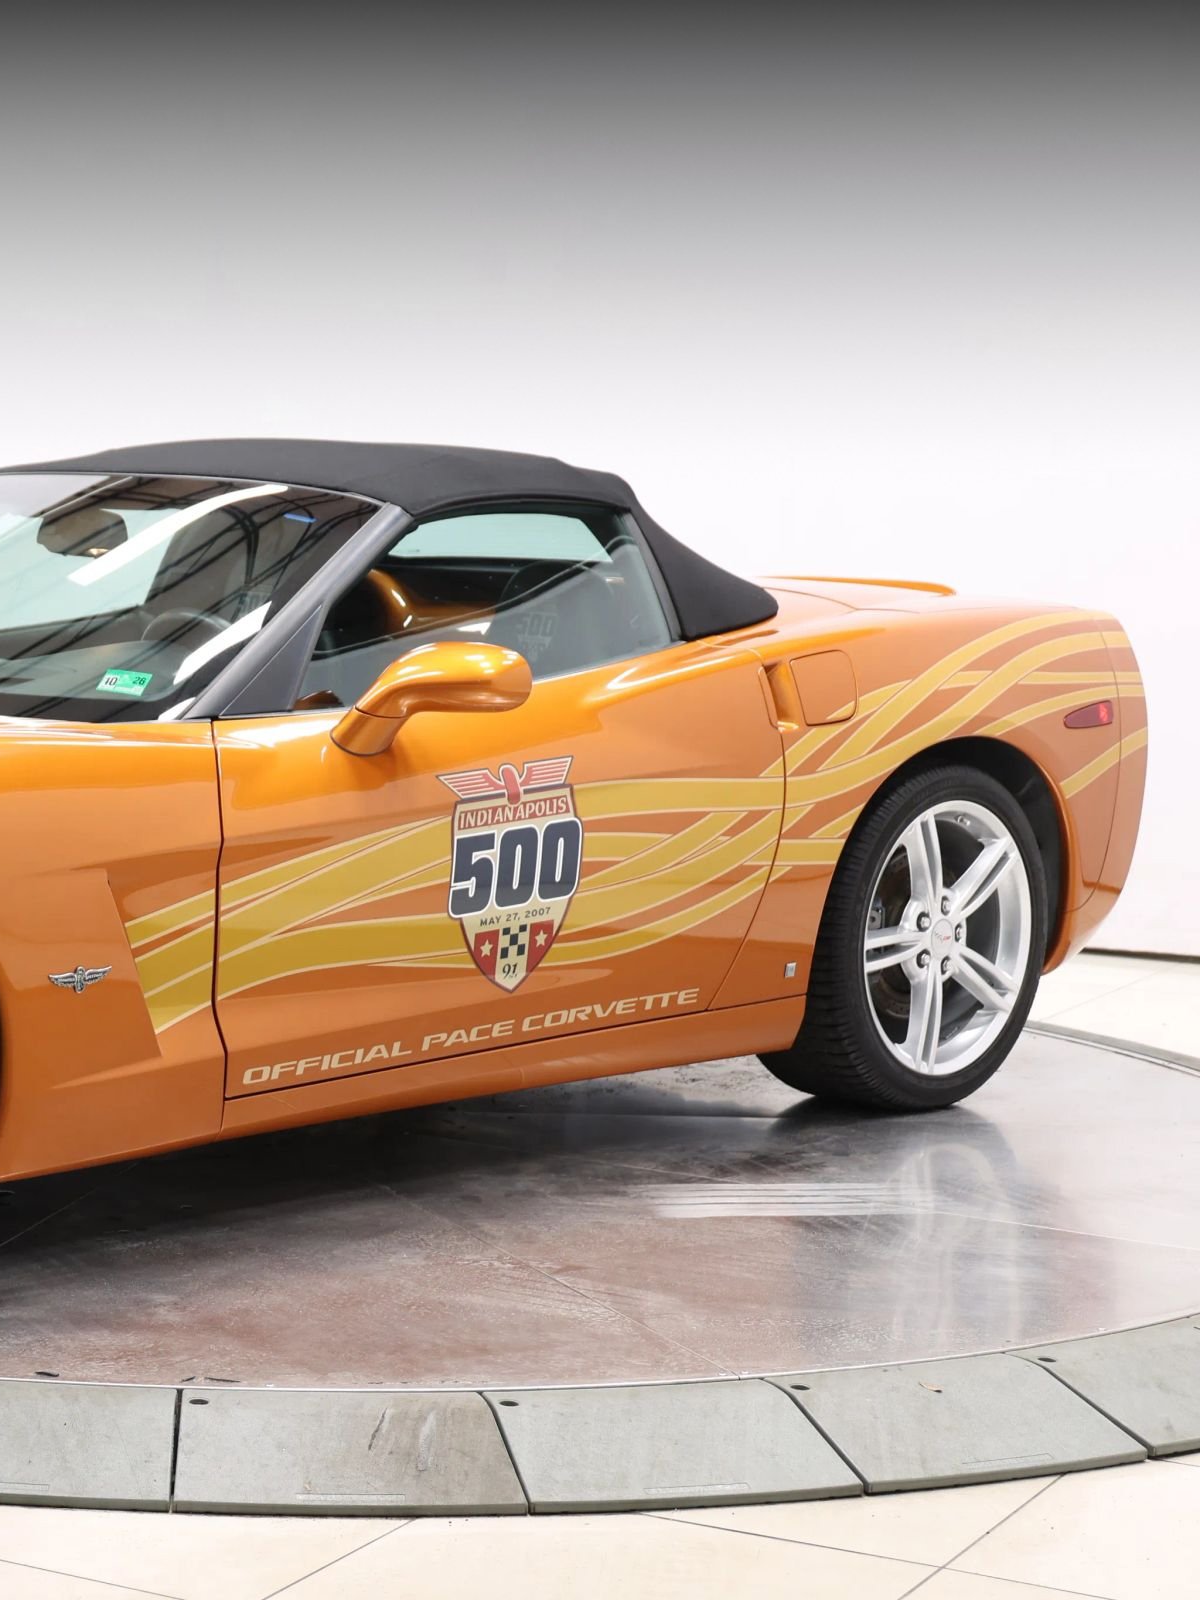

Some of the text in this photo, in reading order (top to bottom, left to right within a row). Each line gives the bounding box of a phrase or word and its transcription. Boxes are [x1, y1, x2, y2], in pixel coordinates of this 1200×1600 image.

[105, 676, 118, 686] 10
[460, 797, 567, 829] INDIANAPOLIS
[449, 817, 582, 918] 500
[480, 906, 551, 927] MAY 27, 2007
[242, 988, 700, 1085] OFFICIAL PACE CORVETTE
